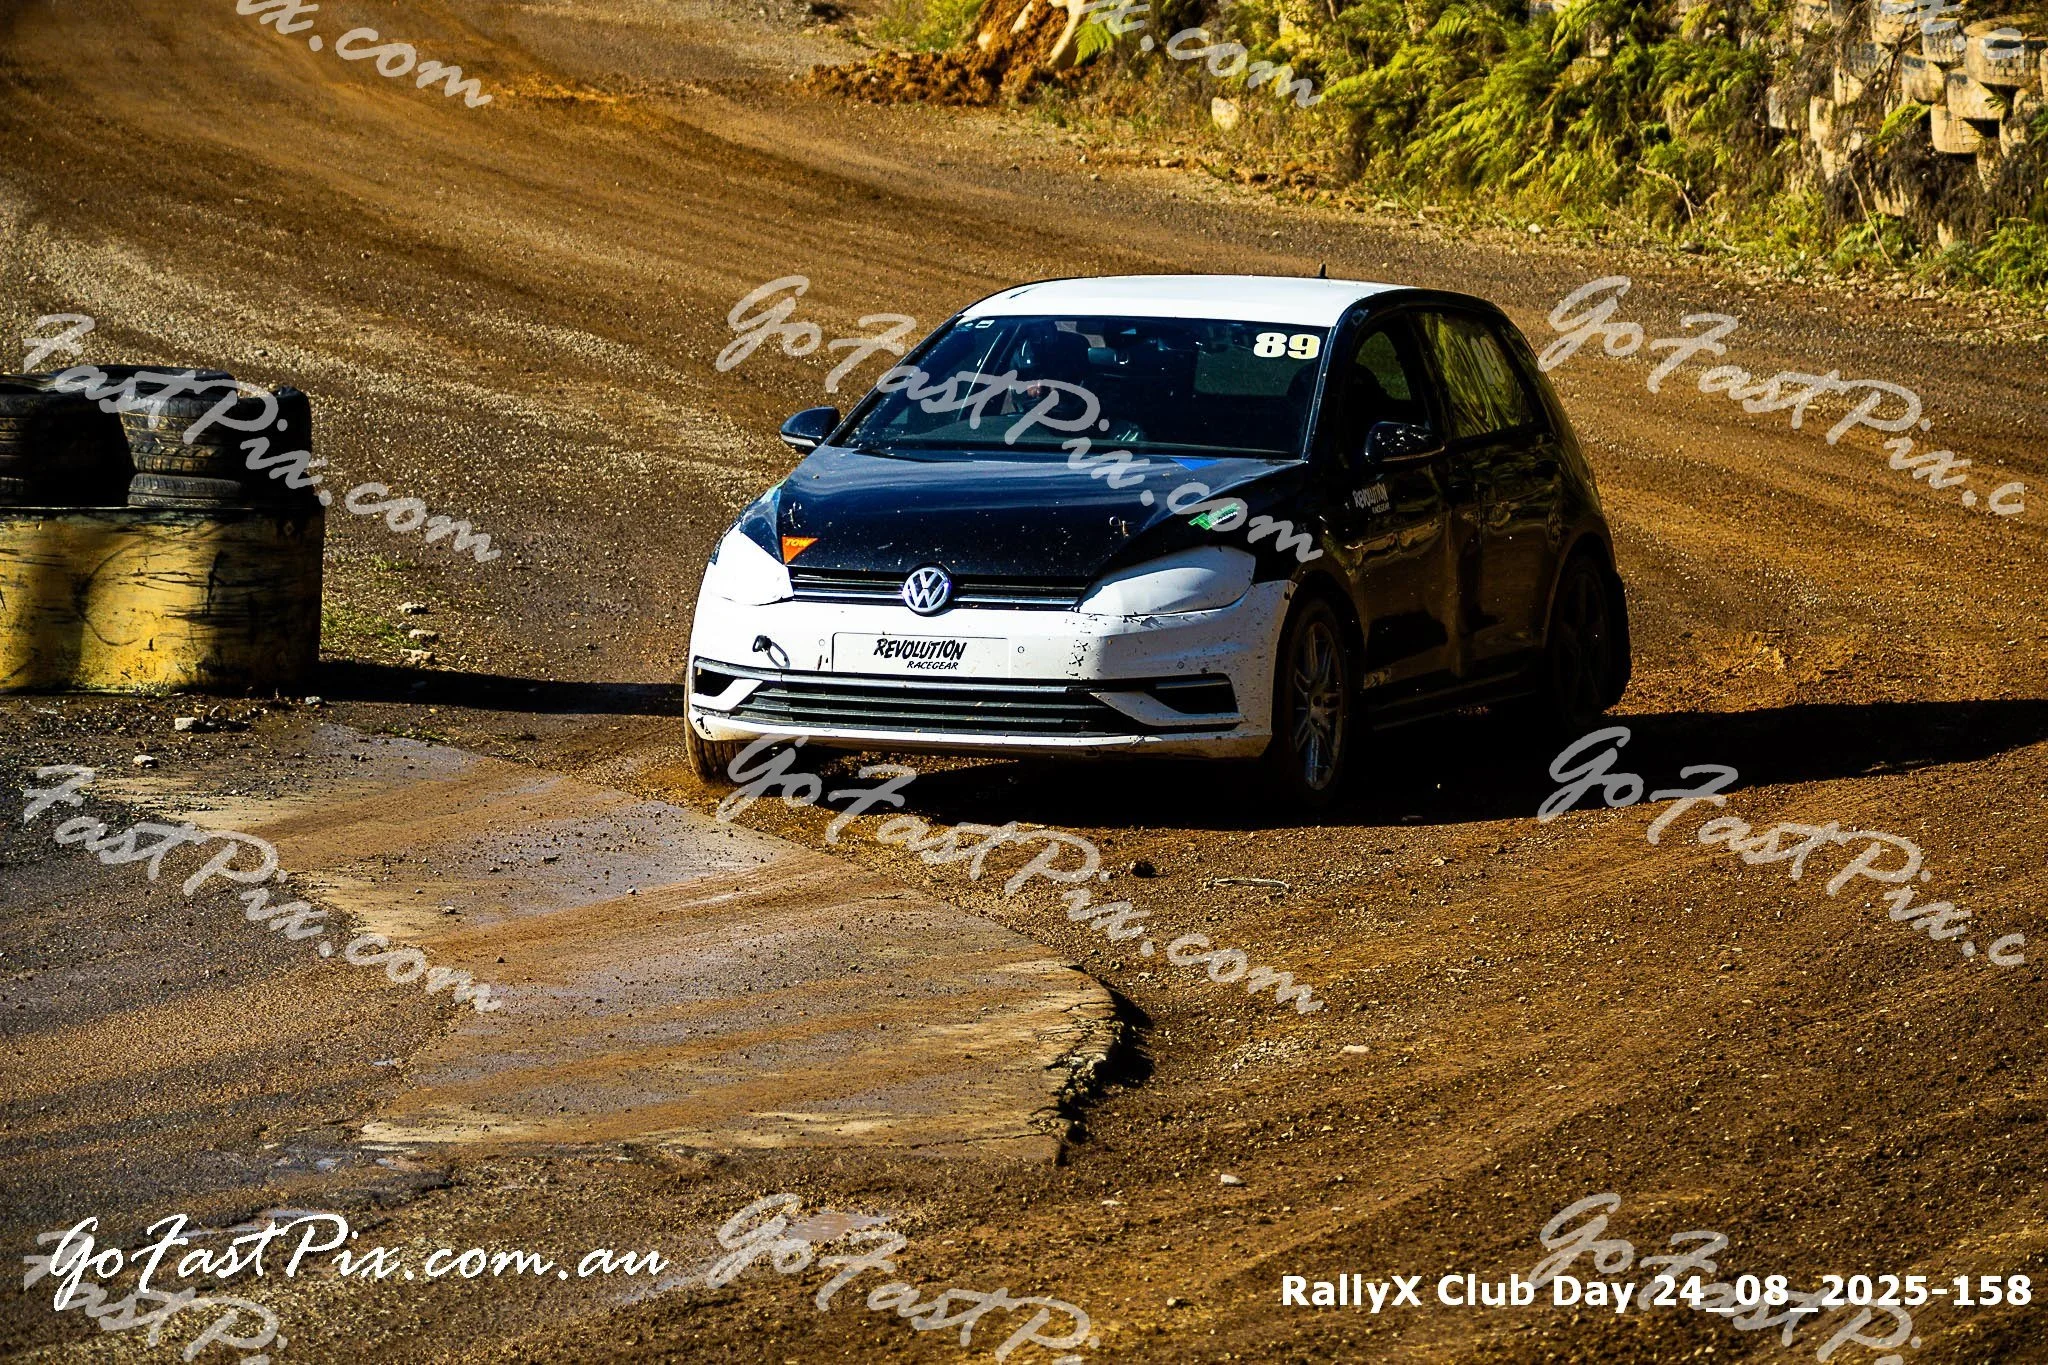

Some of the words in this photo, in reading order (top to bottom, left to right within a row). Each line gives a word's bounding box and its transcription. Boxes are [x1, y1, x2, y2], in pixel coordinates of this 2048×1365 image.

[1253, 332, 1320, 360] 89
[784, 538, 811, 547] TOW
[873, 638, 967, 661] REVOLUTION
[906, 660, 959, 671] RACEGEAR
